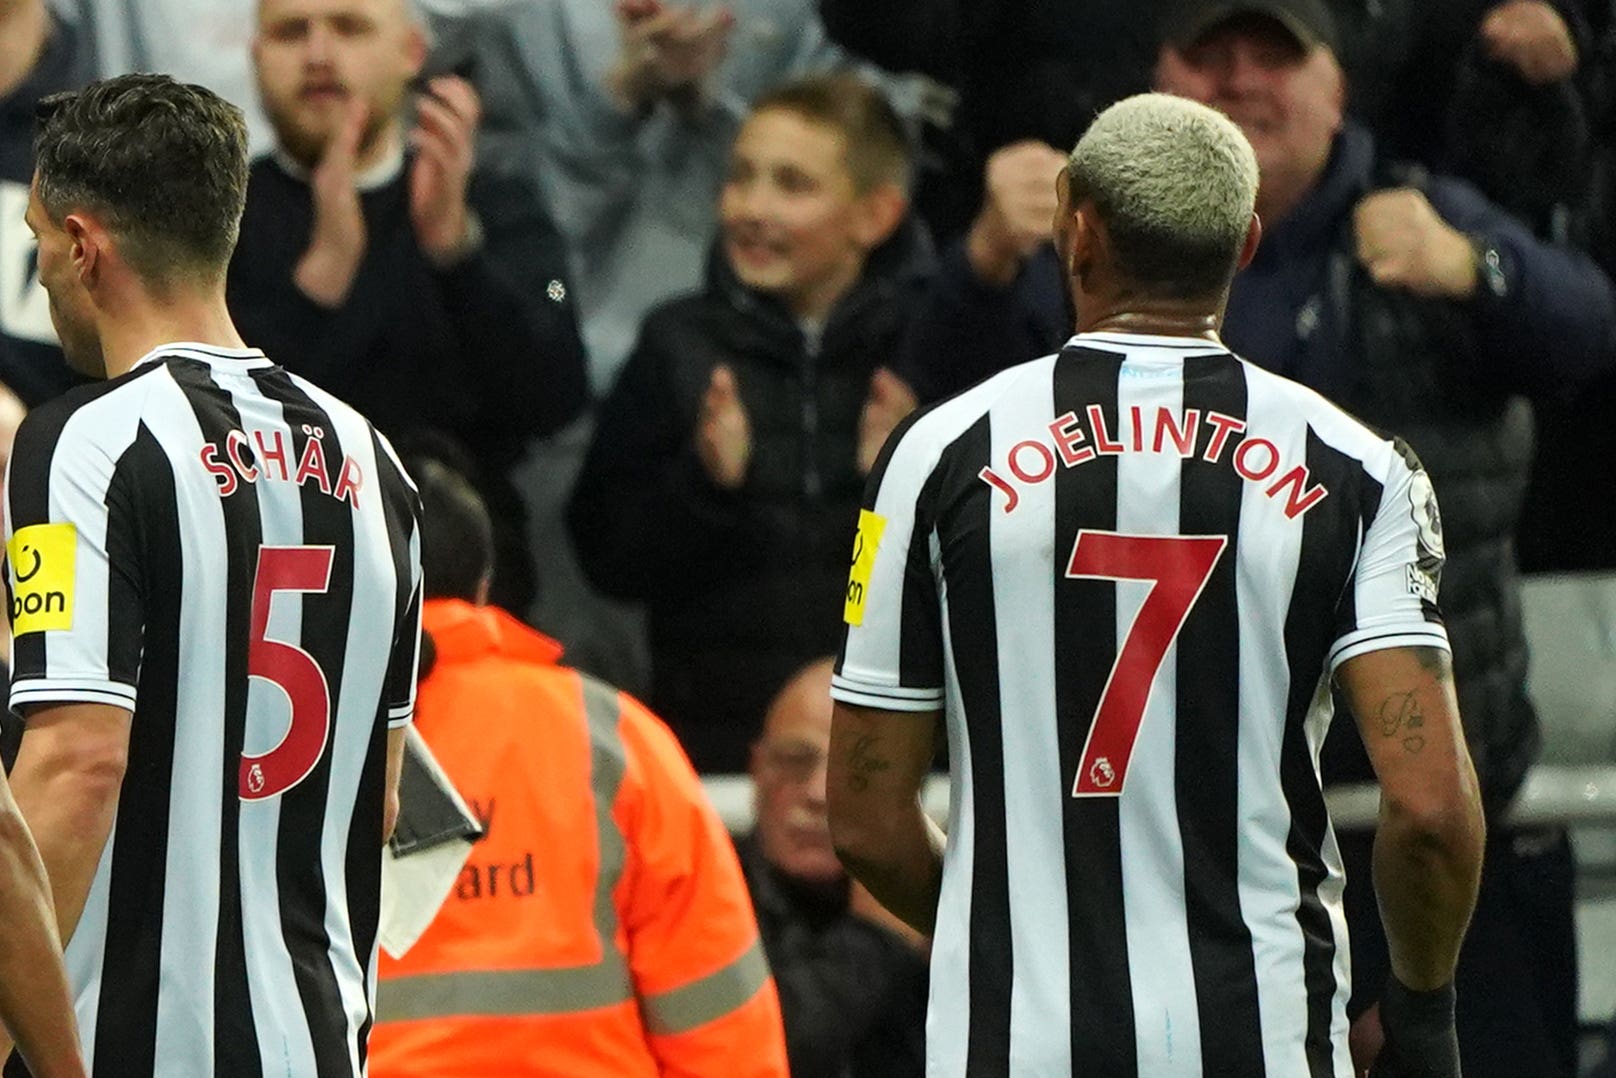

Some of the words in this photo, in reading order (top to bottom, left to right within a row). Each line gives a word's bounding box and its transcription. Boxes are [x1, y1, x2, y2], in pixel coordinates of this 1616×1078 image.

[200, 424, 364, 511] SCHÄR
[978, 403, 1328, 520] JOELINTON
[13, 591, 65, 619] oon
[1065, 528, 1228, 798] 7
[238, 543, 336, 802] 5
